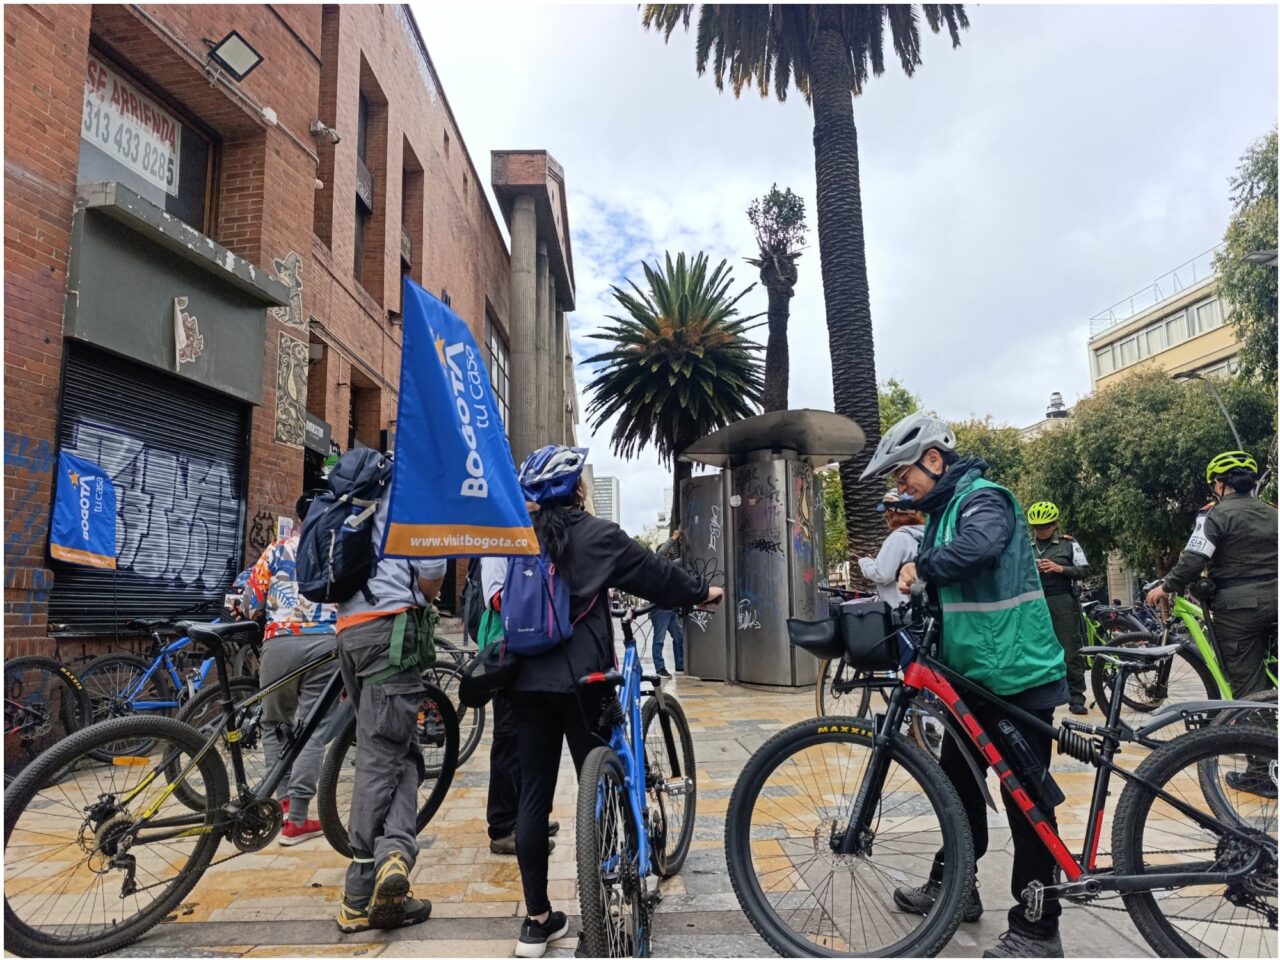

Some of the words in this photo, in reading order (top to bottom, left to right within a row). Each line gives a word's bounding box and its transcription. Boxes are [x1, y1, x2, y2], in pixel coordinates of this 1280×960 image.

[110, 80, 176, 153] ARRIENDA
[84, 100, 110, 143] 313
[114, 123, 140, 163] 433
[142, 142, 174, 186] 8285
[465, 345, 484, 400] casa
[470, 404, 489, 429] tu
[95, 476, 104, 500] casa
[410, 534, 529, 549] www.visitbogota.co
